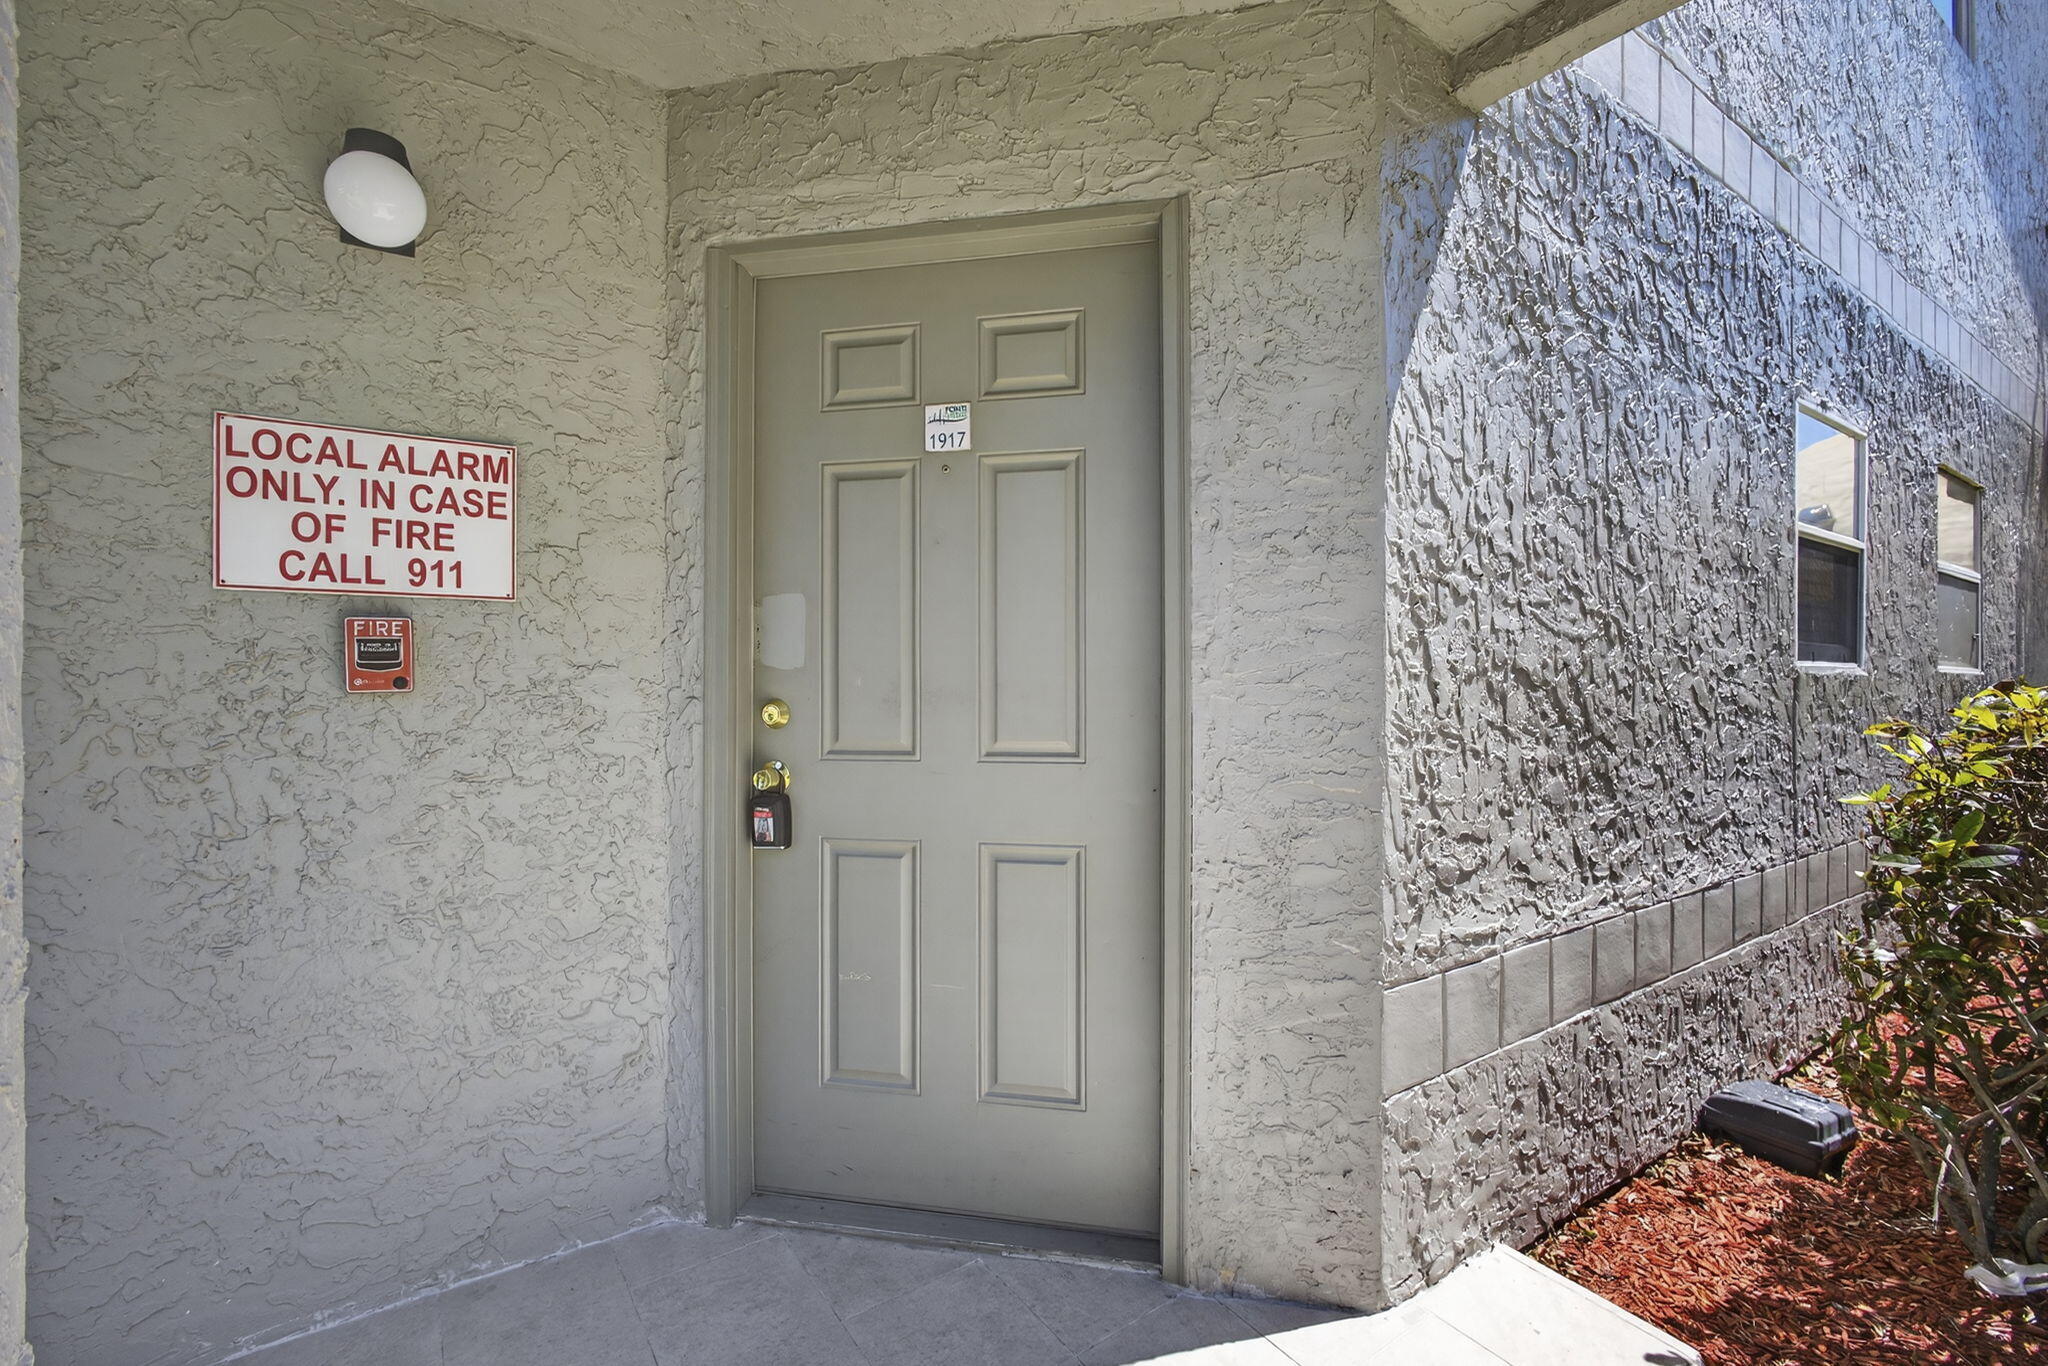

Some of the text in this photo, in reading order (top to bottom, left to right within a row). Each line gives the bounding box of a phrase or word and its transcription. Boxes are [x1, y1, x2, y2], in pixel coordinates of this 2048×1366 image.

[225, 425, 509, 484] LOCAL ALARM
[930, 431, 966, 449] 1917
[226, 466, 507, 520] ONLY. IN CASE
[291, 512, 455, 552] OF FIRE
[279, 550, 462, 589] CALL 911
[354, 620, 403, 636] FIRE
